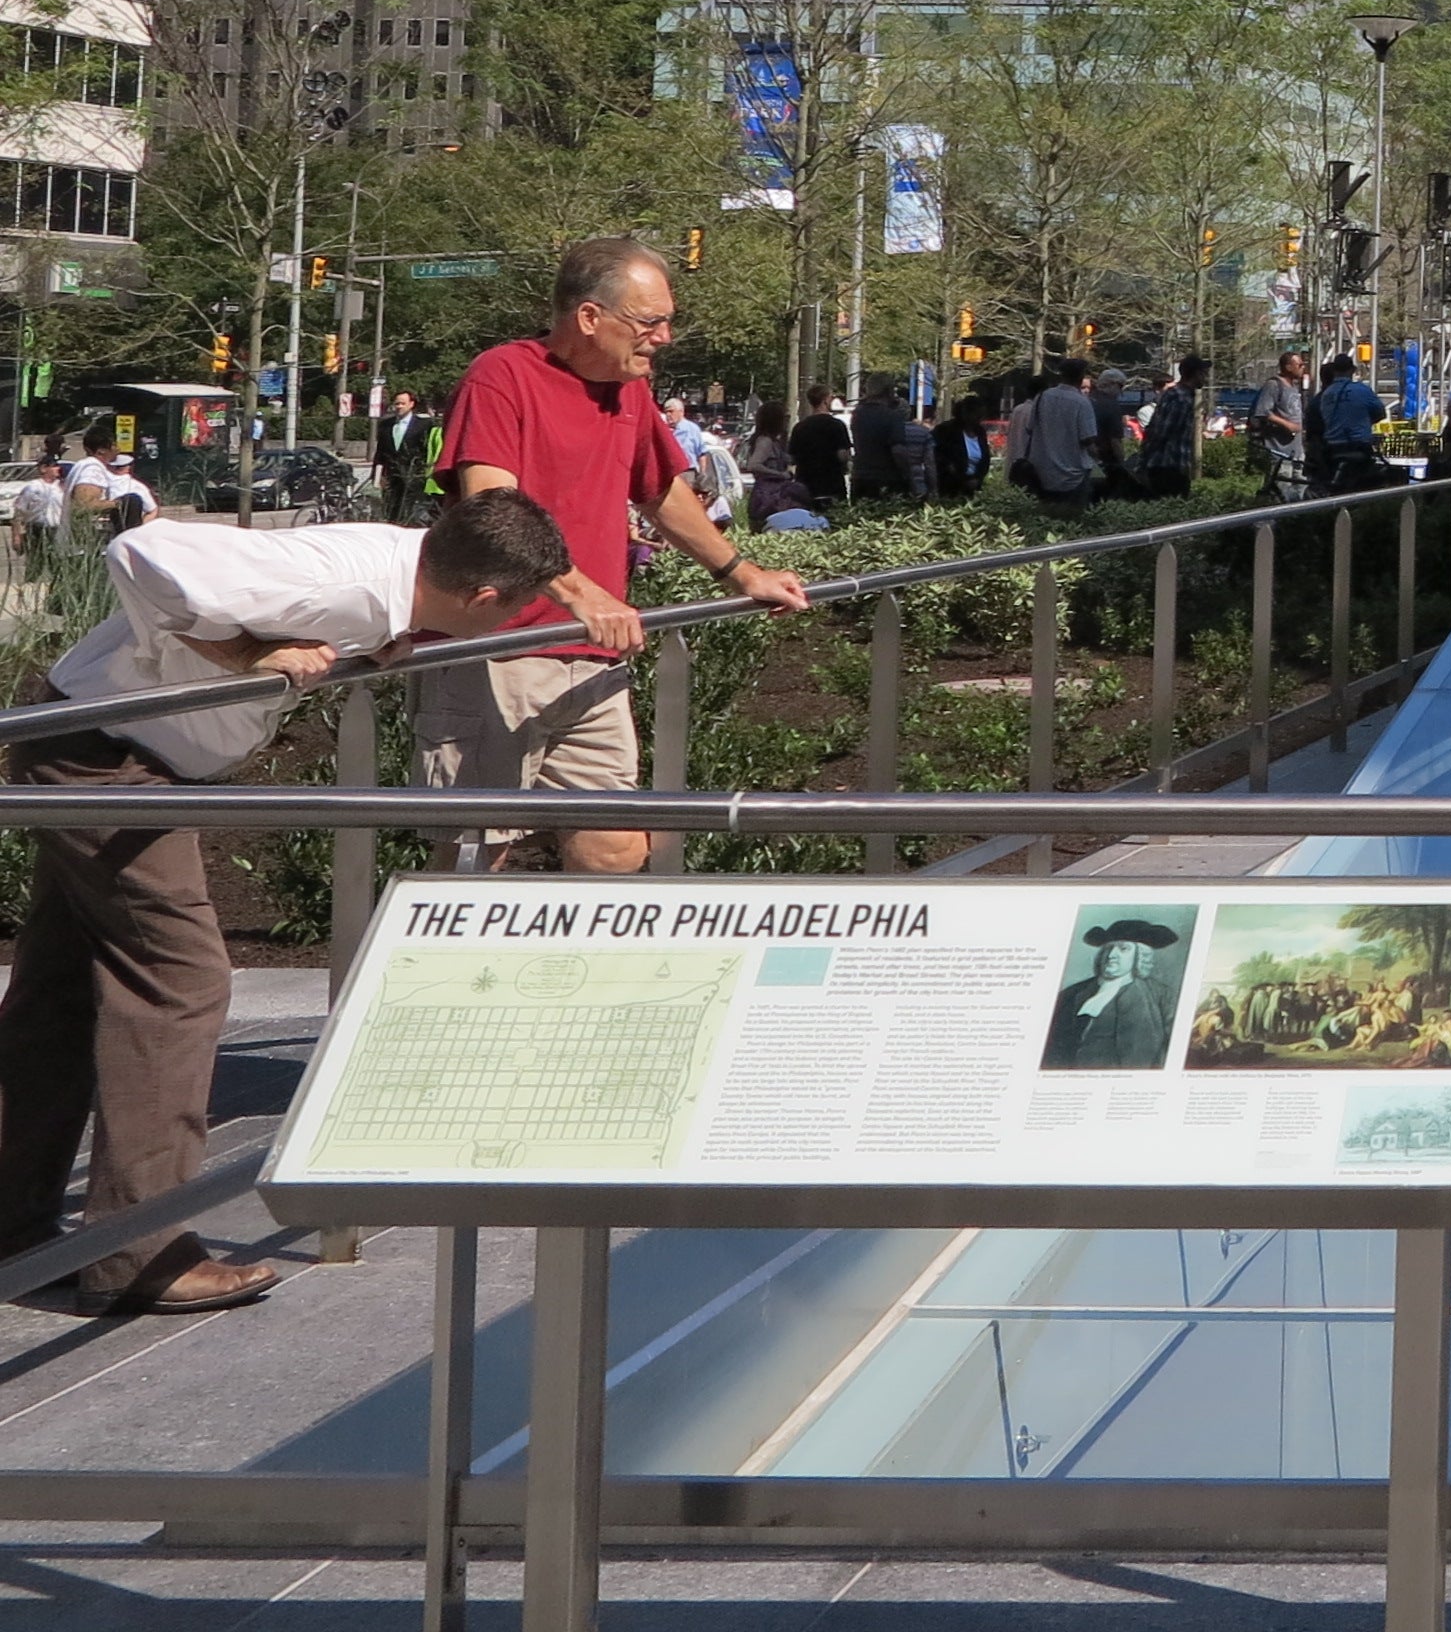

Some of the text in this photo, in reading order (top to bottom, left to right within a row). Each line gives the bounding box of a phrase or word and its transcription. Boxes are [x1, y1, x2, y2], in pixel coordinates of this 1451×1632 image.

[405, 903, 930, 938] THE PLAN FOR PHILADELPHIA
